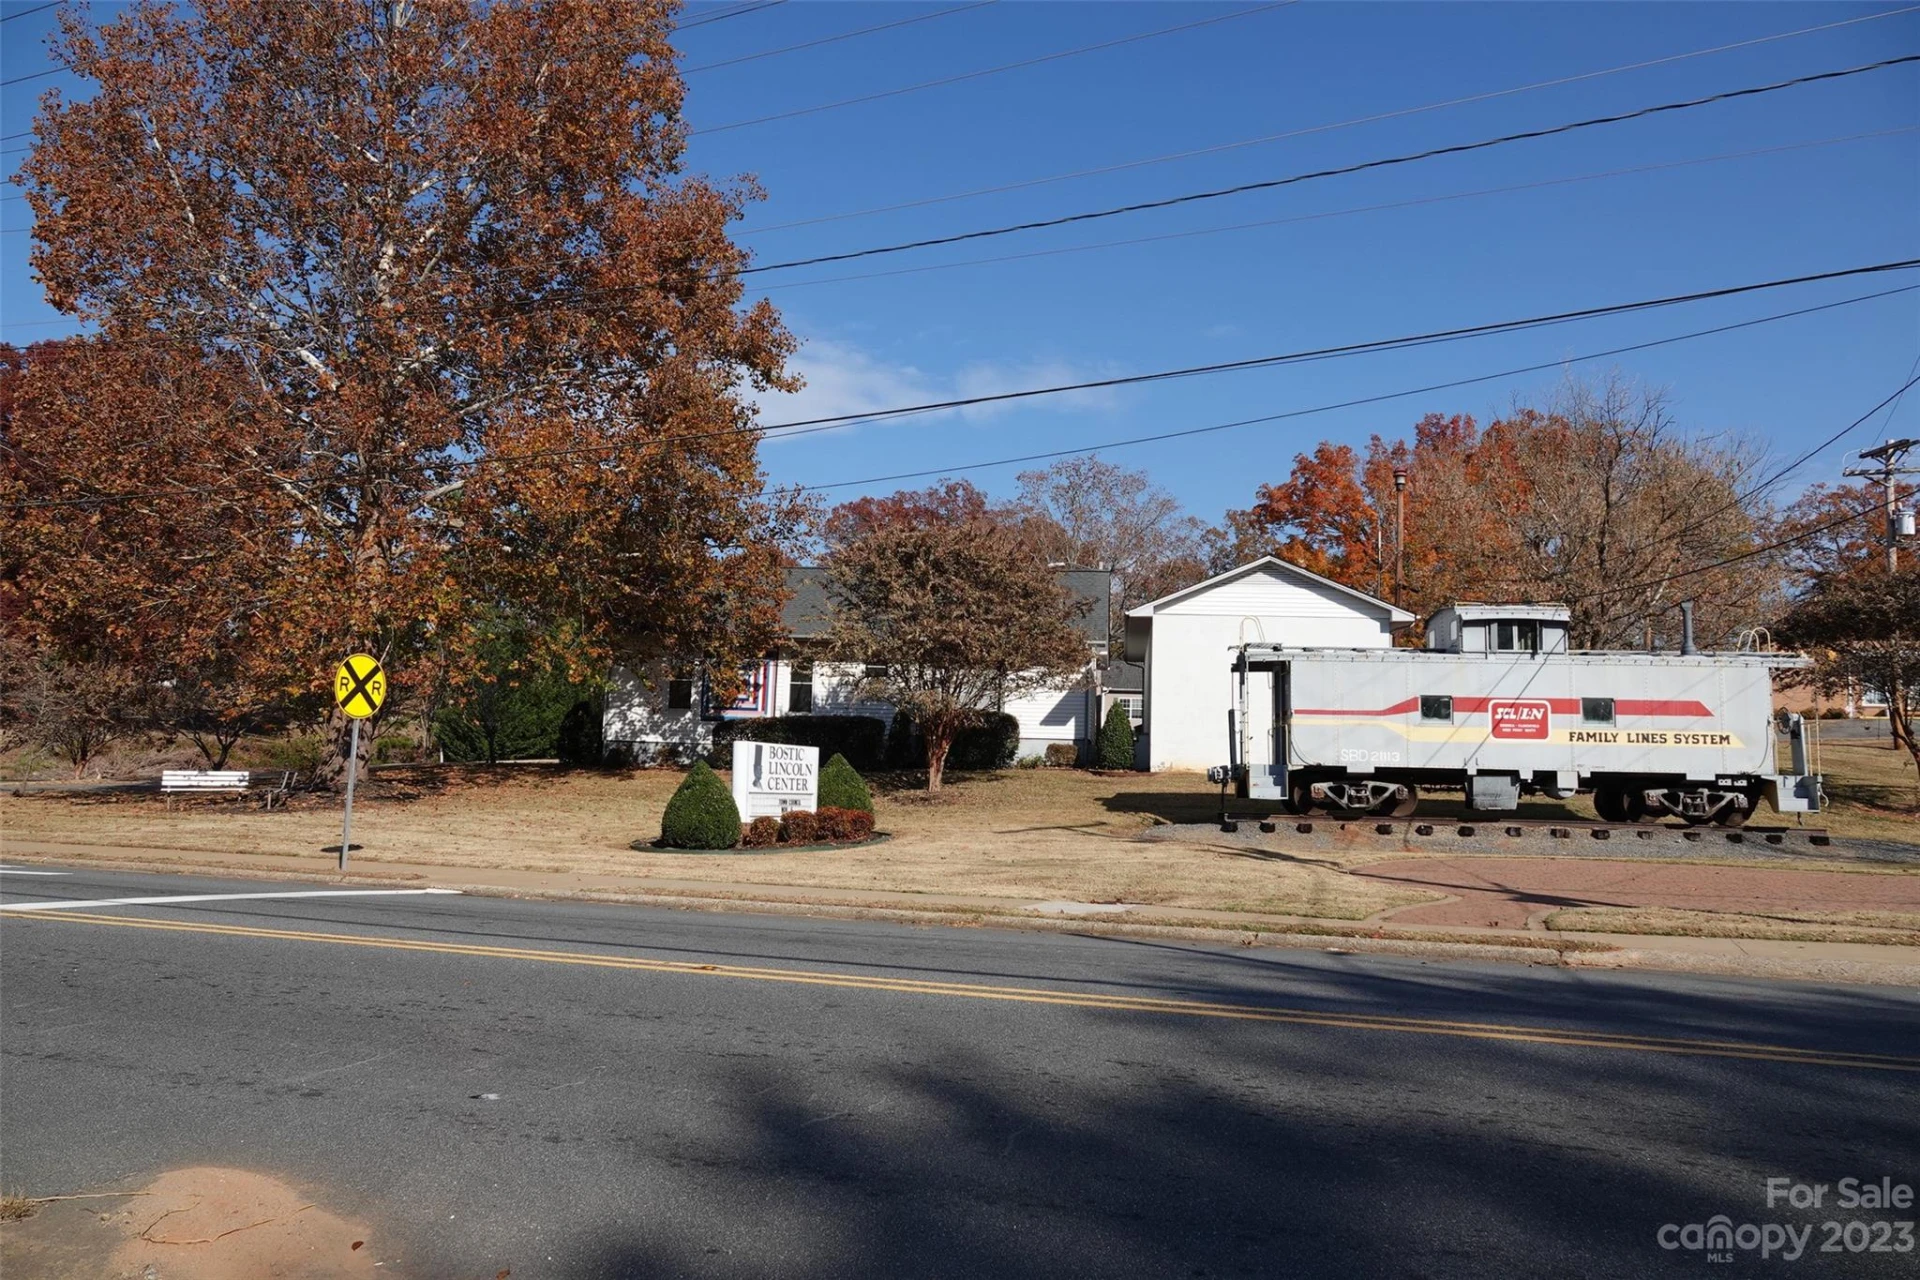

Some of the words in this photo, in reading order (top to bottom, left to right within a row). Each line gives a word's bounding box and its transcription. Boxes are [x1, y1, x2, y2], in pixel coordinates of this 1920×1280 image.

[339, 676, 350, 692] R
[371, 680, 382, 696] R
[1568, 731, 1619, 743] FAMILY
[1627, 732, 1668, 744] LINES
[1673, 733, 1731, 745] SYSTEM
[769, 745, 805, 761] BOSTIC
[1340, 749, 1369, 762] SBD
[768, 761, 813, 777] LINCOLN
[767, 776, 809, 791] CENTER
